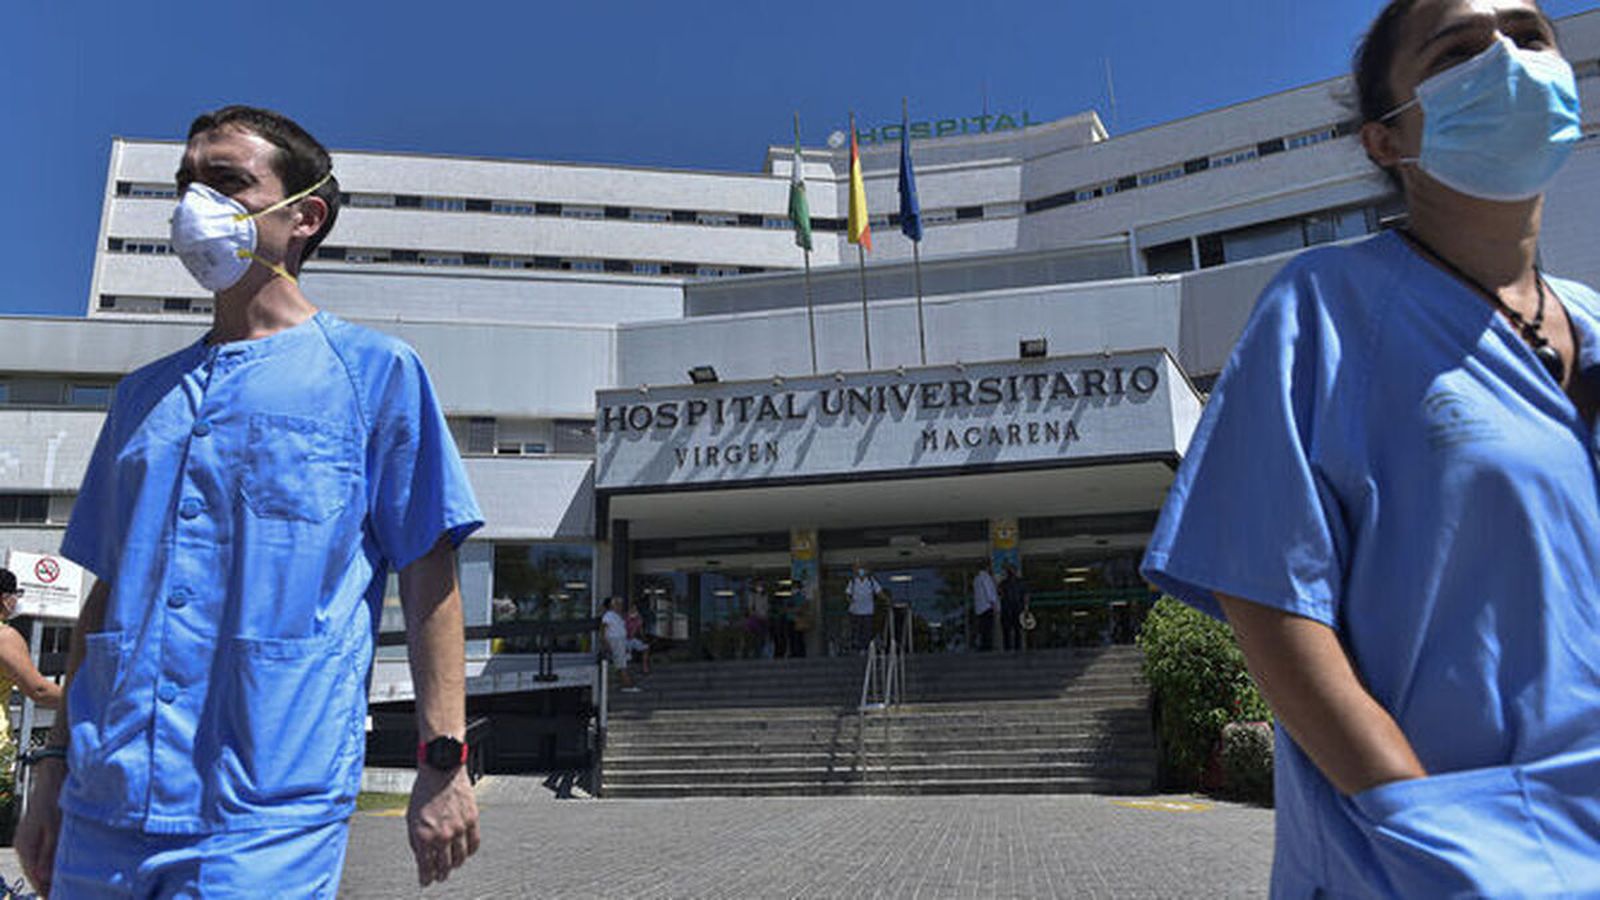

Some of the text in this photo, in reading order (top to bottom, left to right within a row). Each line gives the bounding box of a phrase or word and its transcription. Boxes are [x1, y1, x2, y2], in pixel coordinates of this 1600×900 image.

[856, 110, 1042, 144] HOSPITAL
[602, 365, 1160, 433] HOSPITAL UNIVERSITARIO
[675, 419, 1081, 469] VIRGEN MACARENA
